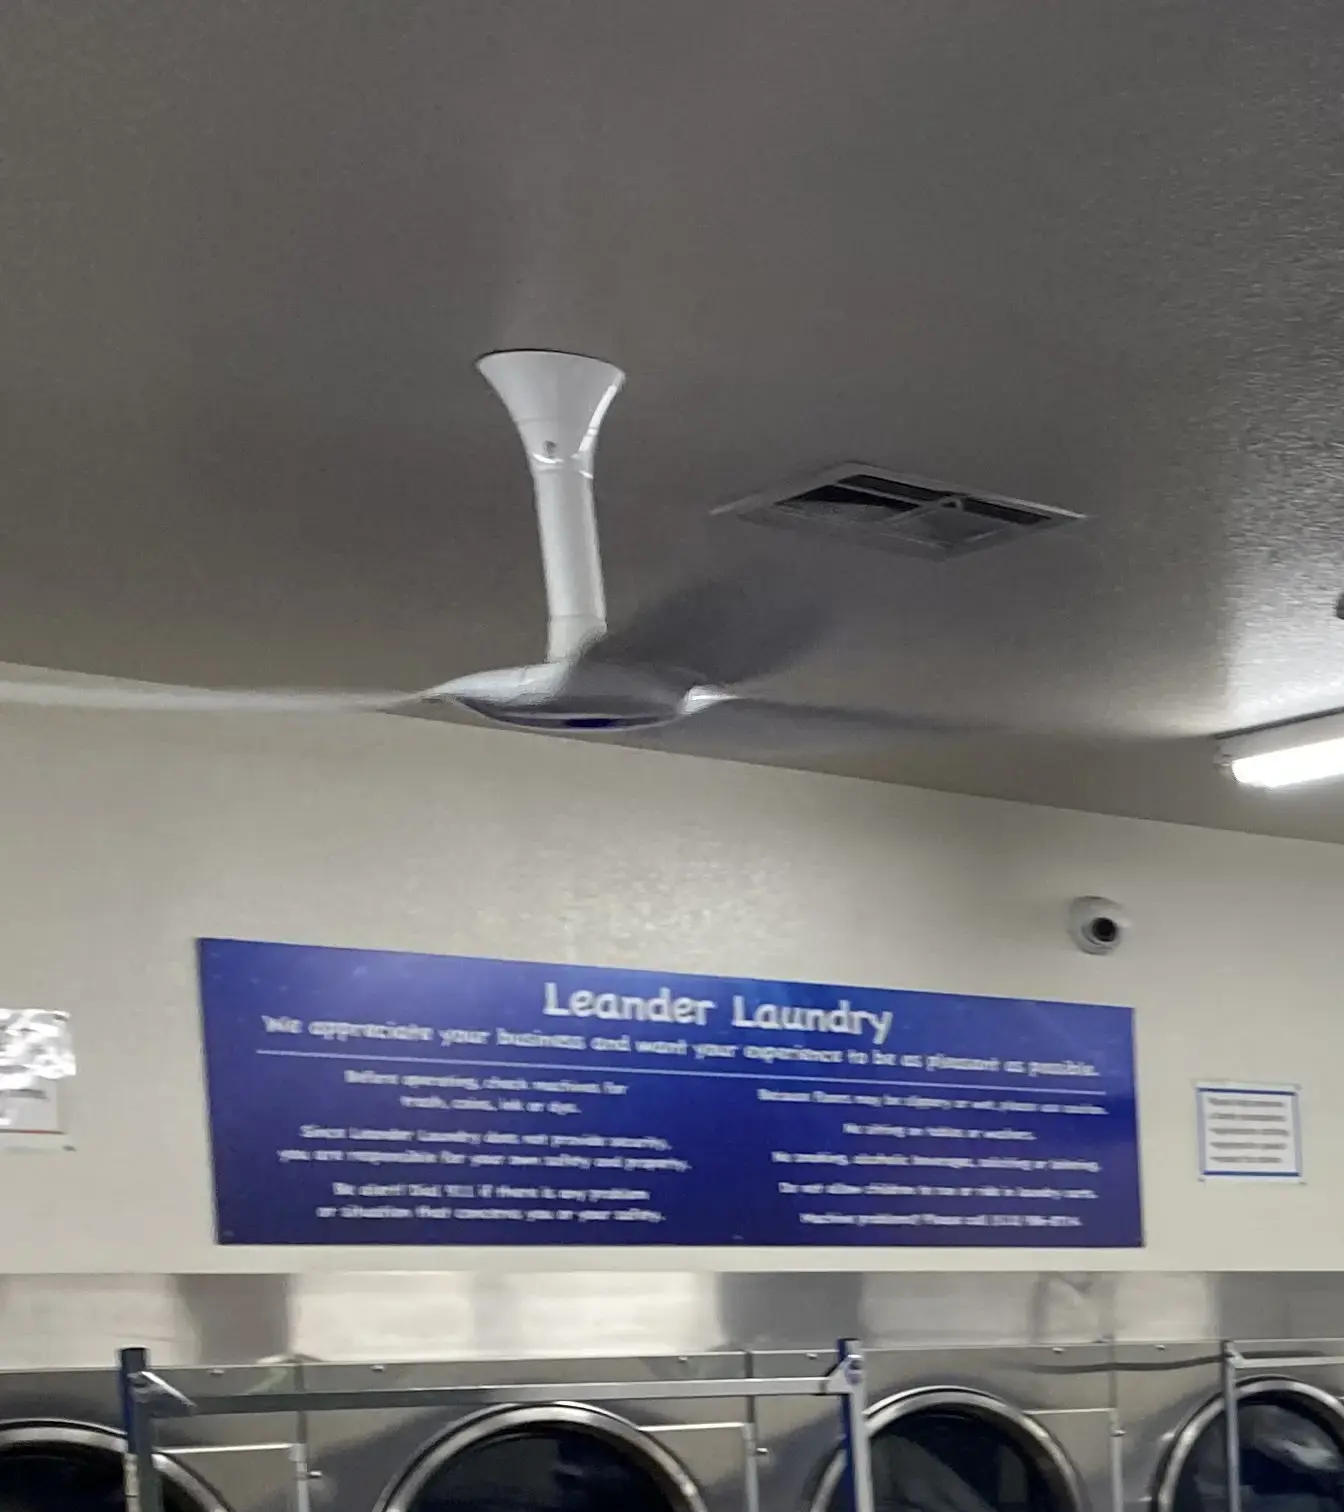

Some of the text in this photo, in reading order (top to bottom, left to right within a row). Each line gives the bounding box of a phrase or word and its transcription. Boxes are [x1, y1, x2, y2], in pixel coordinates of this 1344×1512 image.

[543, 982, 893, 1045] Leander Laundry
[261, 1015, 301, 1034] We
[309, 1021, 433, 1042] appreciate
[439, 1028, 490, 1046] your
[496, 1028, 585, 1050] business
[590, 1034, 630, 1052] and
[636, 1039, 687, 1054] want
[693, 1043, 736, 1061] your
[744, 1045, 842, 1064] experience
[848, 1049, 868, 1065] to
[873, 1049, 896, 1066] be
[900, 1054, 922, 1068] as
[926, 1053, 999, 1073] pleasant
[1004, 1060, 1027, 1073] as
